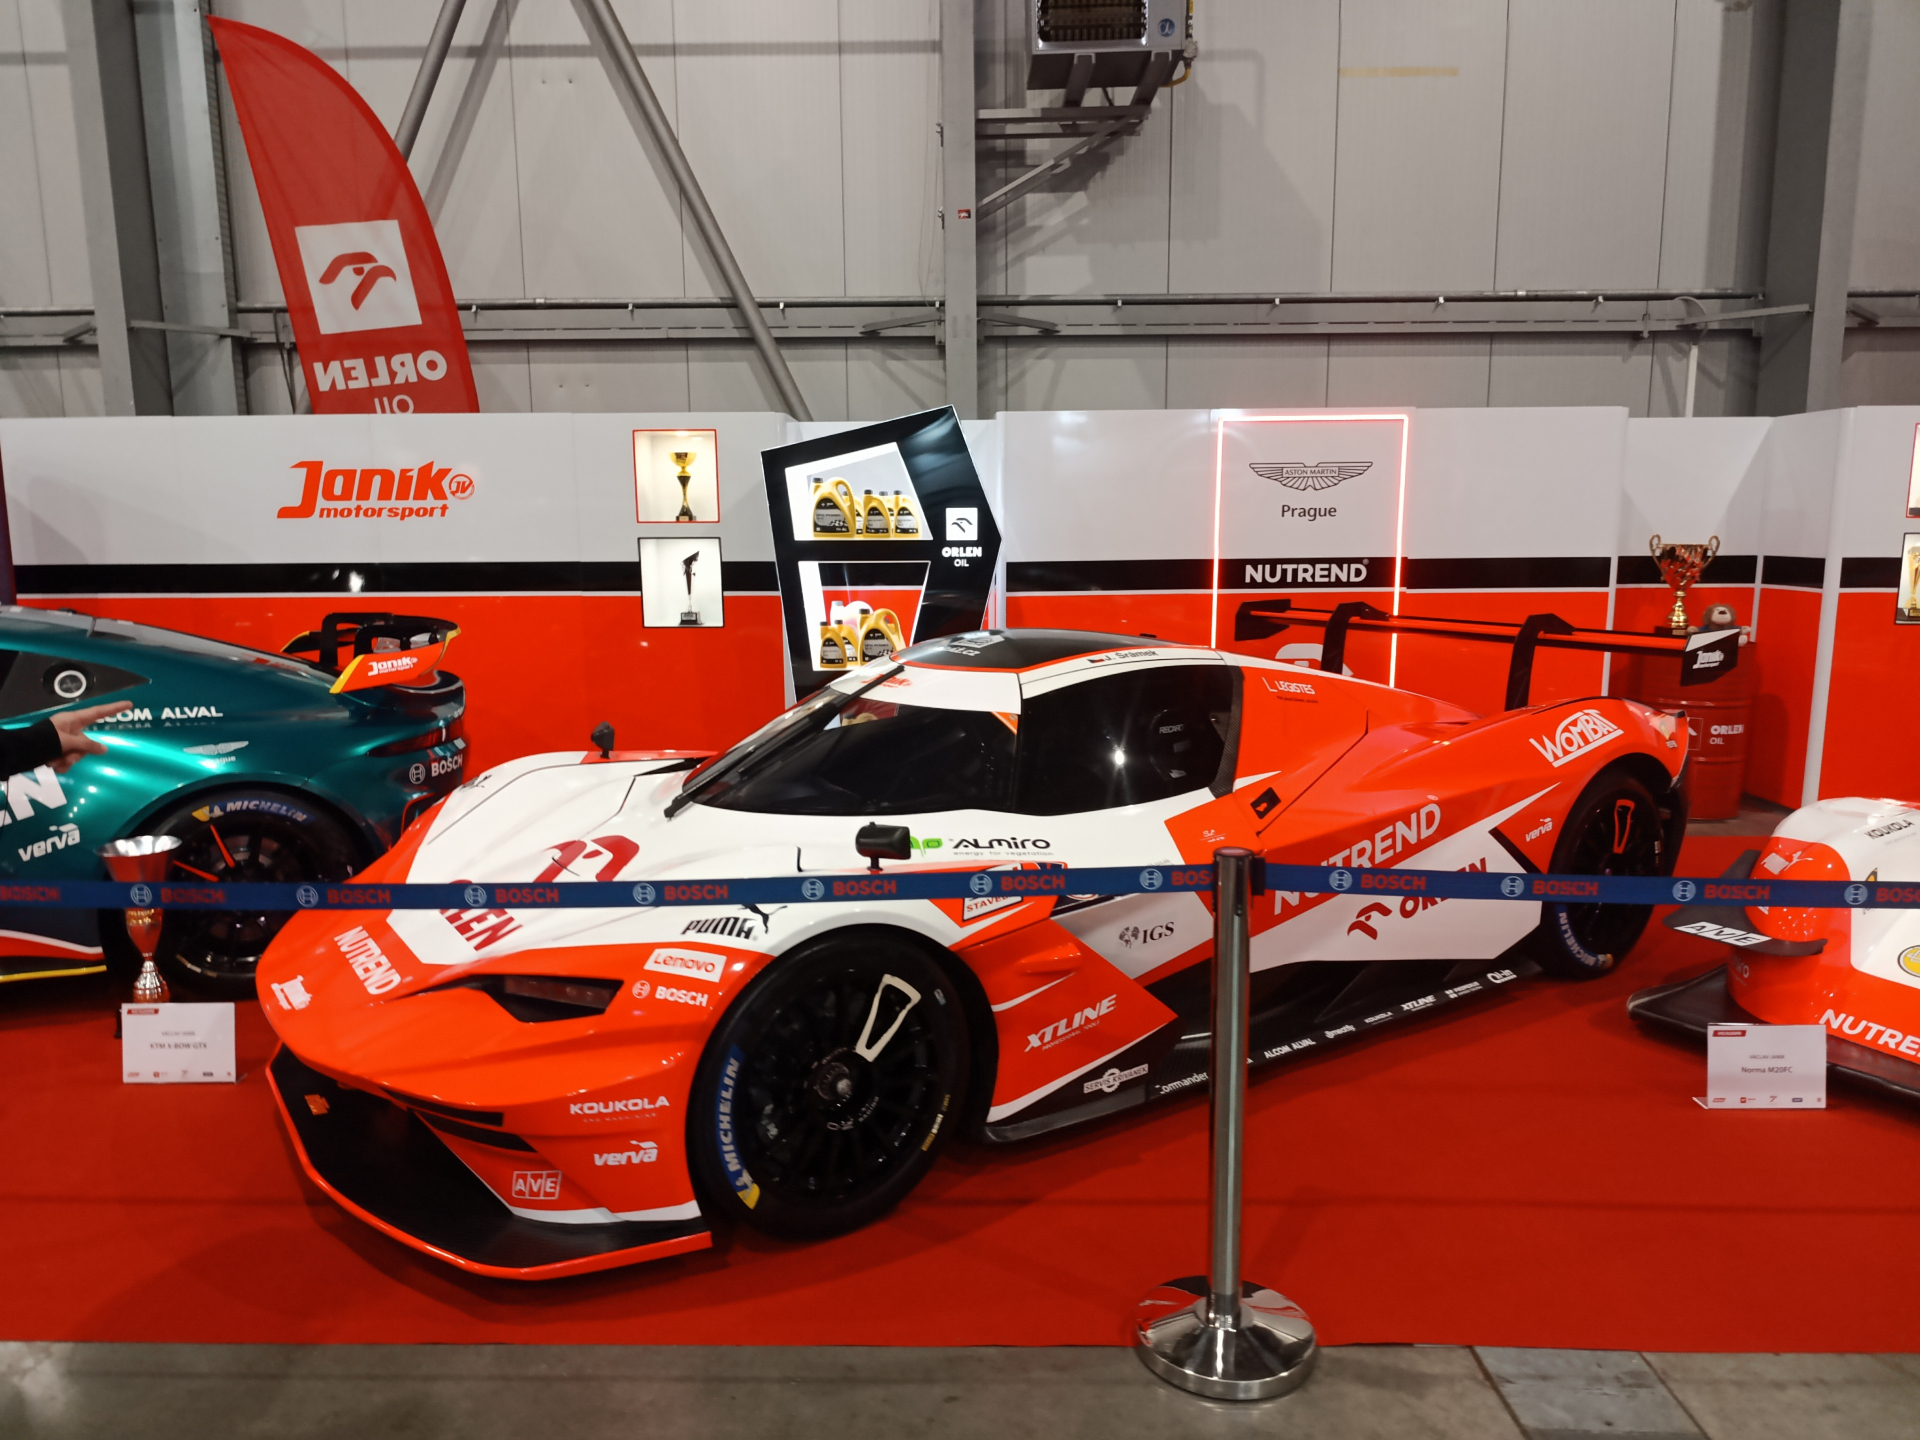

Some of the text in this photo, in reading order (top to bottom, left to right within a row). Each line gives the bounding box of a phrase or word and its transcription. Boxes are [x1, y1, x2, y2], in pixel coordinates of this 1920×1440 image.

[1284, 468, 1308, 476] ASTON
[319, 503, 449, 521] motorsport
[1281, 504, 1338, 522] Prague
[941, 546, 983, 558] ORLEN
[953, 558, 970, 567] OIL
[1244, 563, 1367, 583] NUTREND
[1274, 680, 1316, 695] LEGISTES
[161, 705, 224, 720] ALVAL
[1159, 724, 1184, 734] RECARO
[1709, 736, 1725, 746] OIL
[431, 753, 463, 777] BOSCH
[225, 800, 308, 822] MICHELIN
[1525, 818, 1553, 842] verva
[1863, 819, 1916, 839] KOUKOLA
[18, 825, 81, 862] verva
[160, 887, 226, 904] BOSCH
[327, 888, 392, 905] BOSCH
[494, 888, 560, 903] BOSCH
[664, 884, 729, 901] BOSCH
[832, 879, 897, 896] BOSCH
[1001, 874, 1066, 891] BOSCH
[1360, 873, 1427, 891] BOSCH
[1532, 880, 1599, 896] BOSCH
[1704, 884, 1770, 901] BOSCH
[681, 916, 756, 940] PUMA
[1142, 921, 1175, 944] IGS
[1684, 925, 1762, 944] AVE
[1558, 912, 1598, 967] MICHELIN
[333, 925, 402, 995] NUTREND
[653, 952, 716, 973] Lenovo
[655, 985, 709, 1008] BOSCH
[1400, 994, 1437, 1011] XTLINE
[1023, 994, 1117, 1052] XTLINE
[1263, 1037, 1317, 1059] ALCOM ALVAL
[1741, 1066, 1793, 1074] Norma M20FC
[1084, 1075, 1112, 1092] SERVIS
[569, 1096, 670, 1115] KOUKOLA
[717, 1057, 742, 1173] MICHELIN
[593, 1145, 659, 1167] verva
[513, 1176, 558, 1194] AVE
